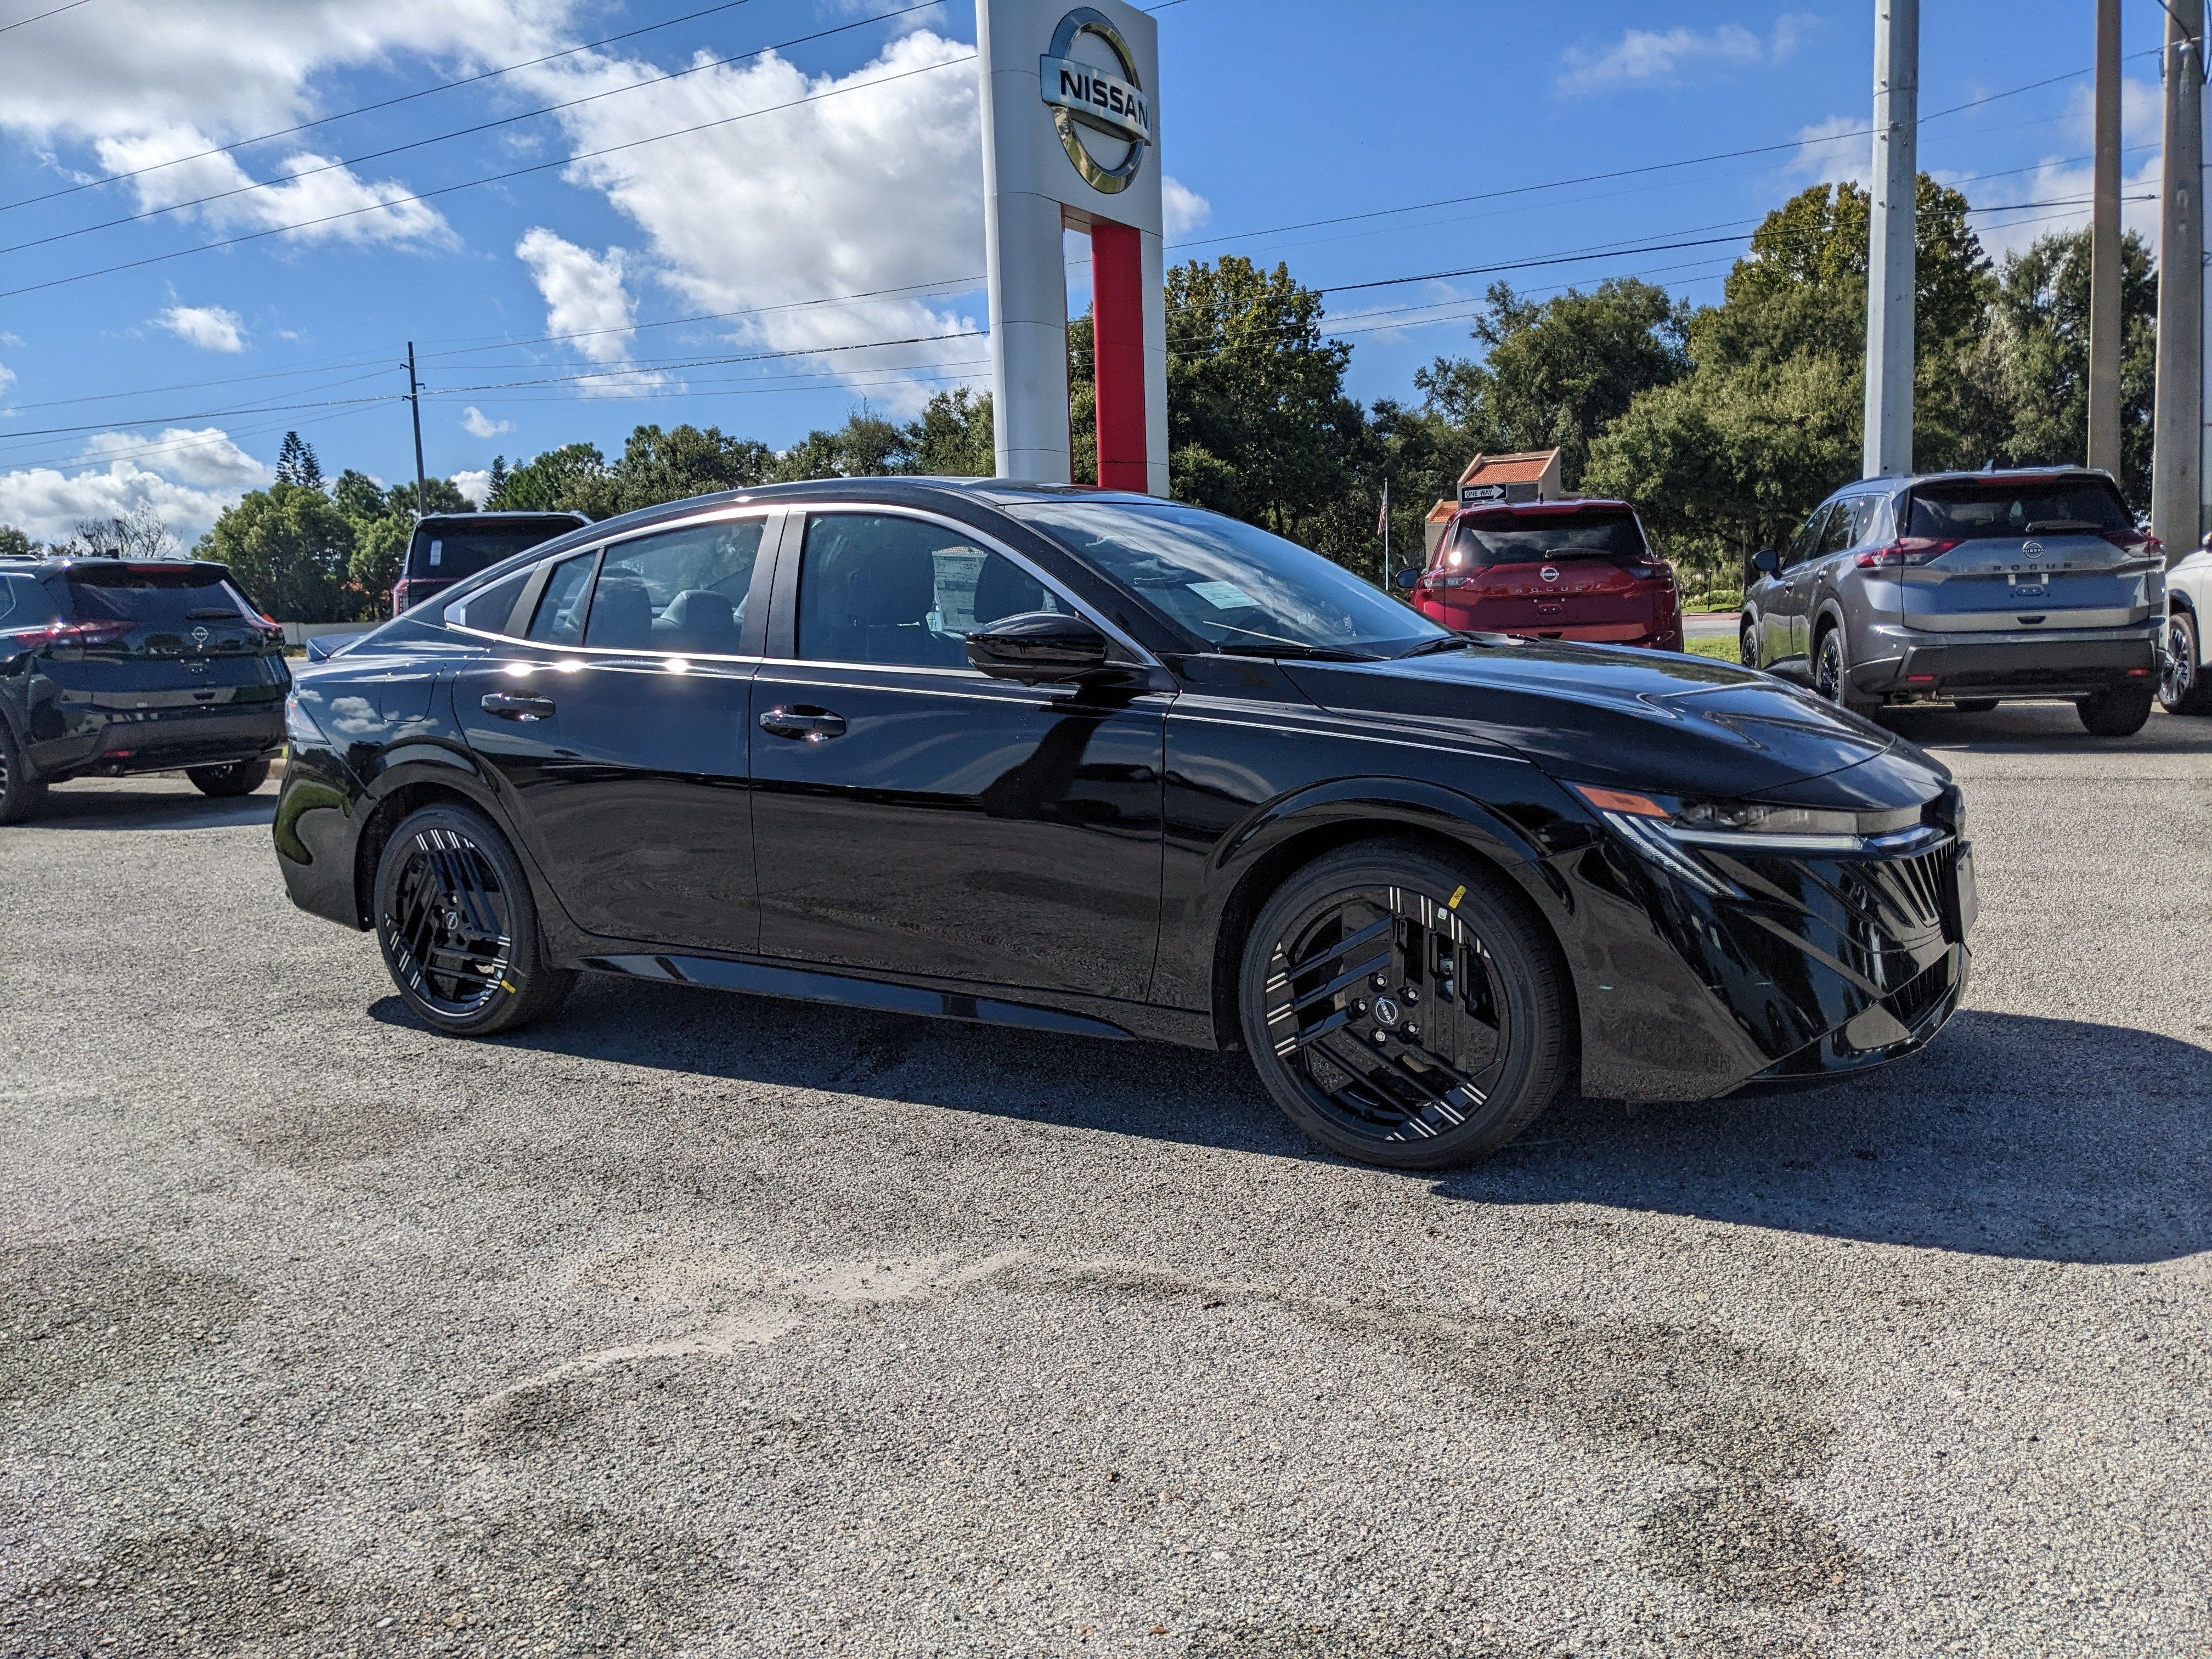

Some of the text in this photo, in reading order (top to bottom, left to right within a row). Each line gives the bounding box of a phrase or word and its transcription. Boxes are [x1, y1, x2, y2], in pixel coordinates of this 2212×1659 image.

[1060, 69, 1148, 131] NISSAN
[1993, 562, 2072, 571] ROGUE
[1516, 585, 1583, 594] ROGUE
[1378, 997, 1395, 1025] NISSAN
